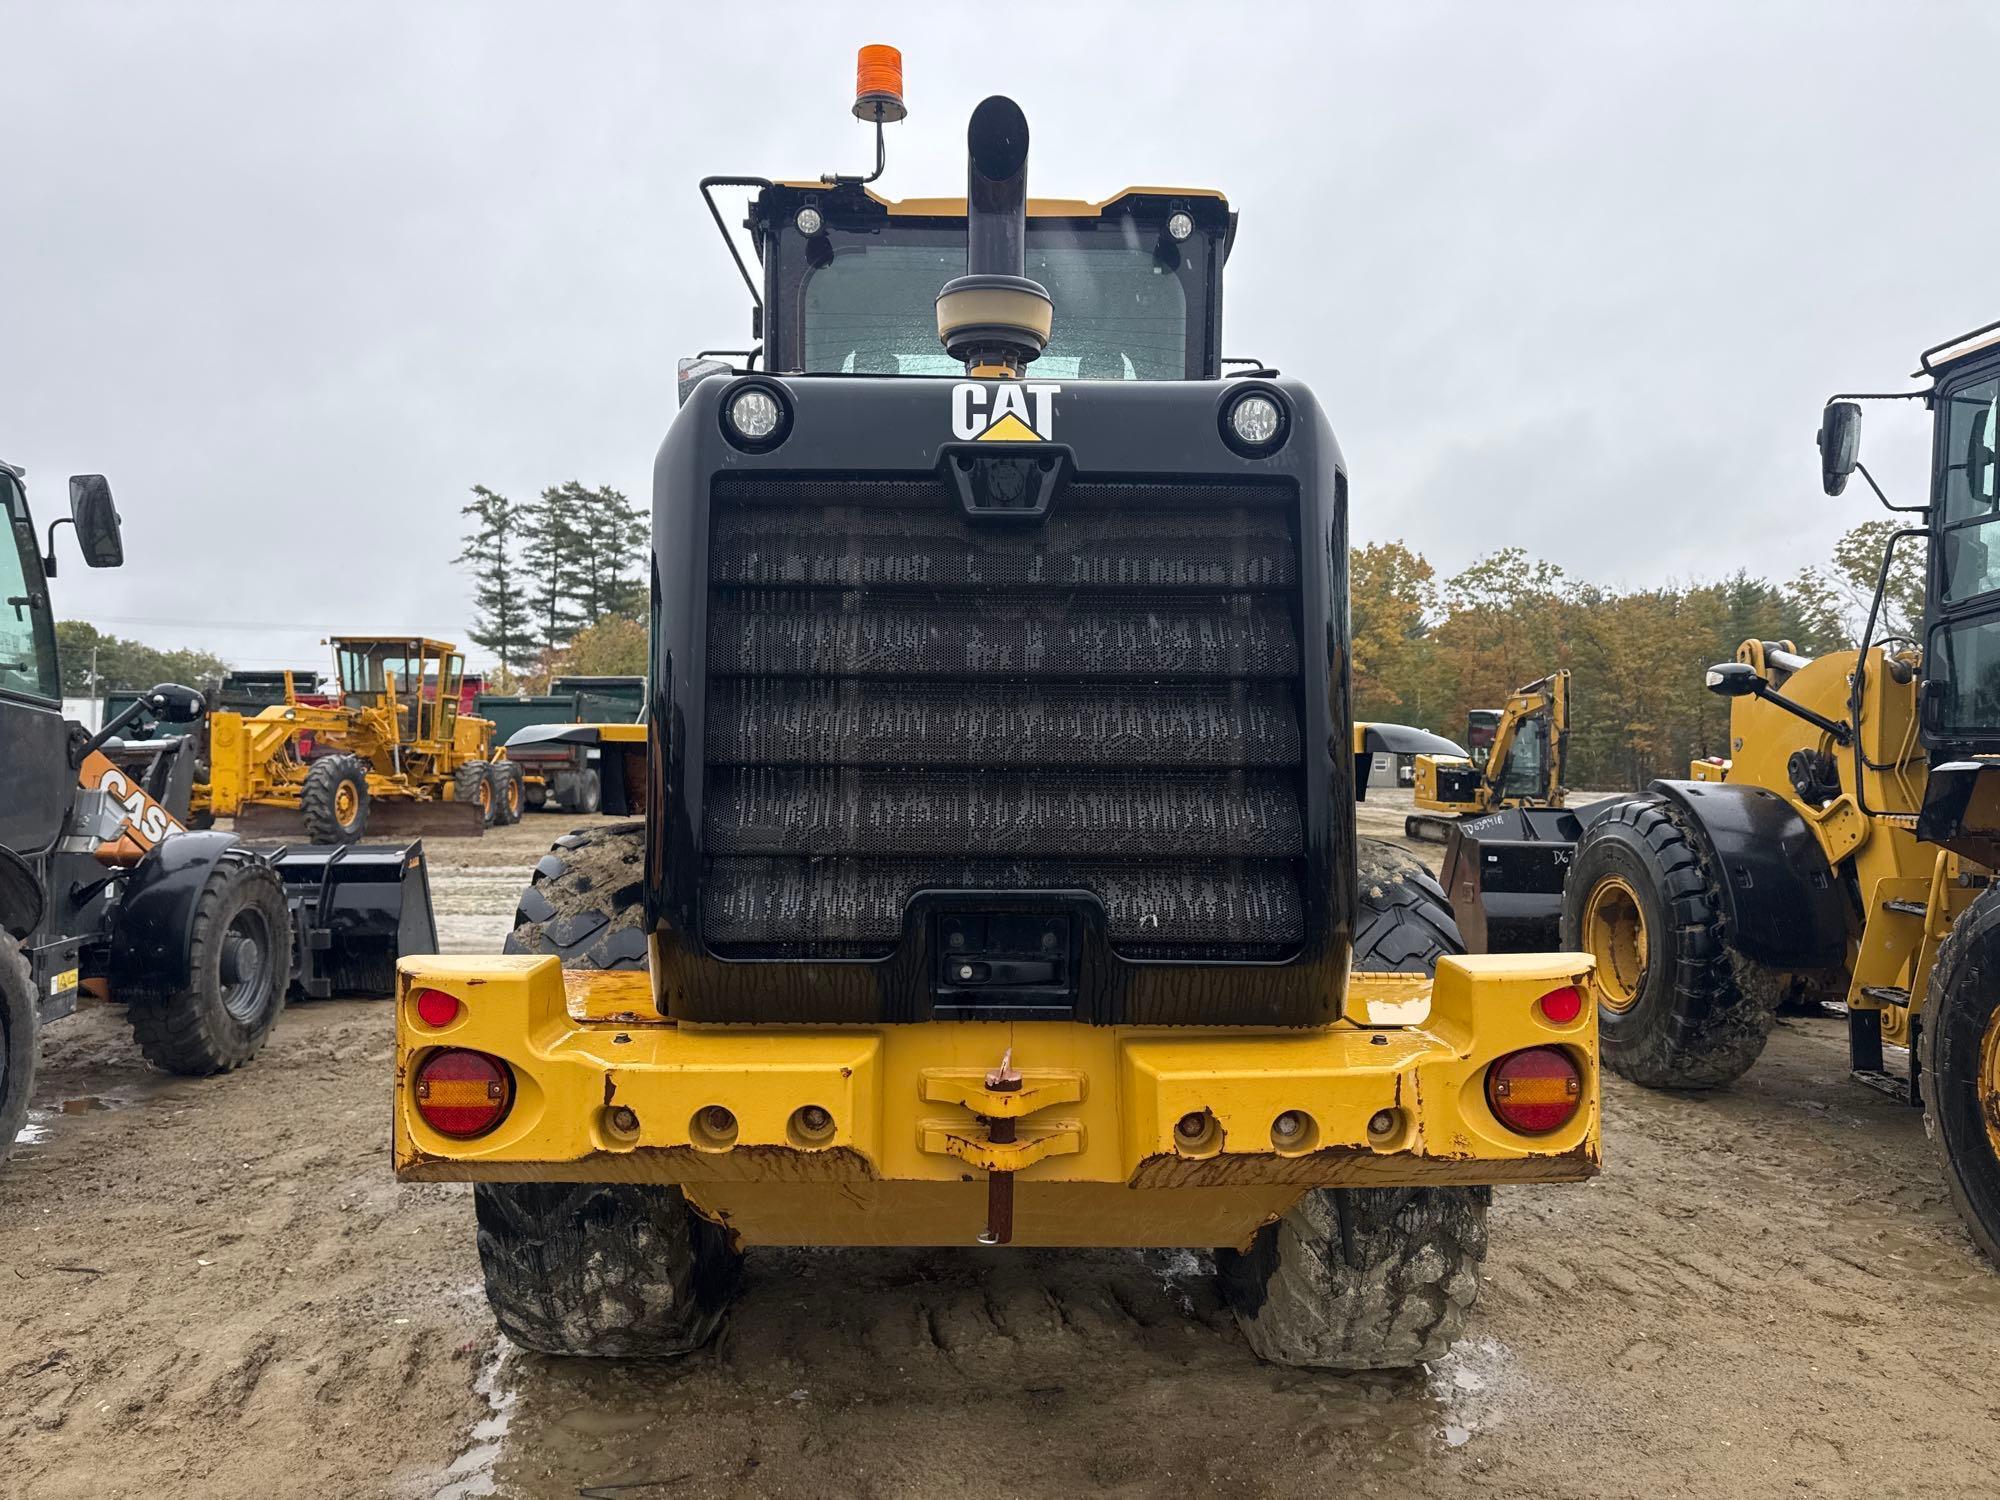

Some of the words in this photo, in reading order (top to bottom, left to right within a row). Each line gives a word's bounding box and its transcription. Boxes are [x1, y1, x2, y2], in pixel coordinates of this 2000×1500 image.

[952, 383, 1061, 441] CAT
[100, 771, 183, 843] CAS
[1552, 850, 1574, 865] D6
